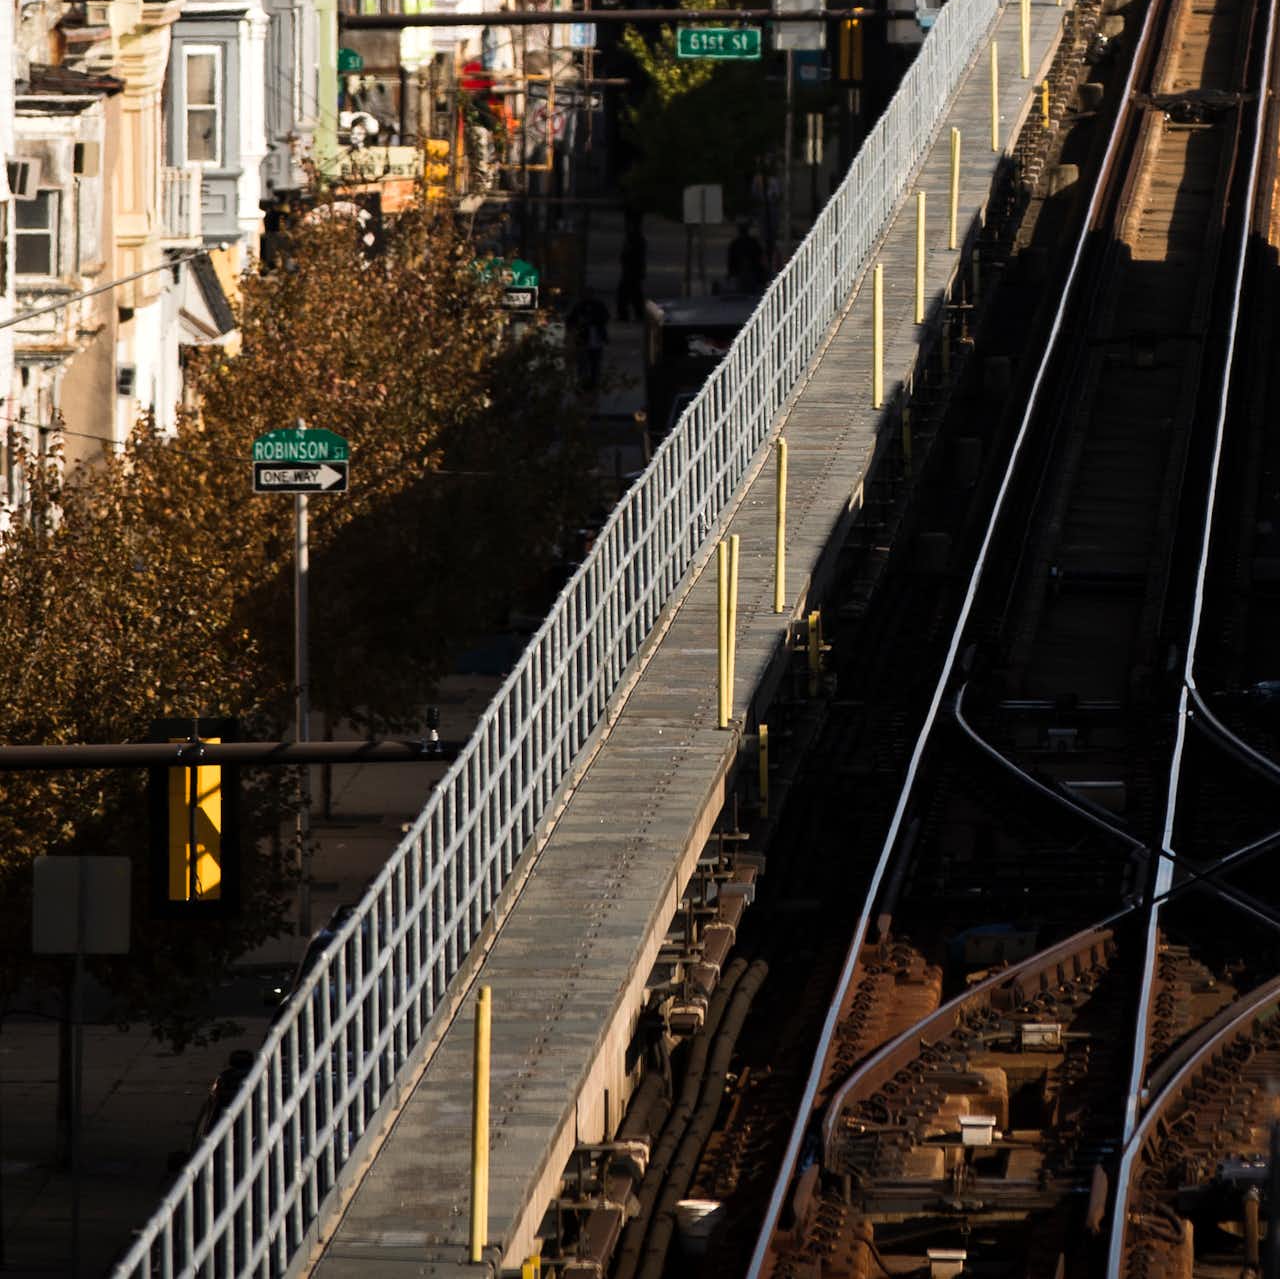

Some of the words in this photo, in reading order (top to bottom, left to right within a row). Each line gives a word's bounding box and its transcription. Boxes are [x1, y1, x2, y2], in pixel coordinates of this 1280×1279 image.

[689, 33, 724, 50] 61st
[255, 441, 329, 459] ROBINSON
[264, 472, 288, 482] ONE
[293, 471, 319, 482] WAY
